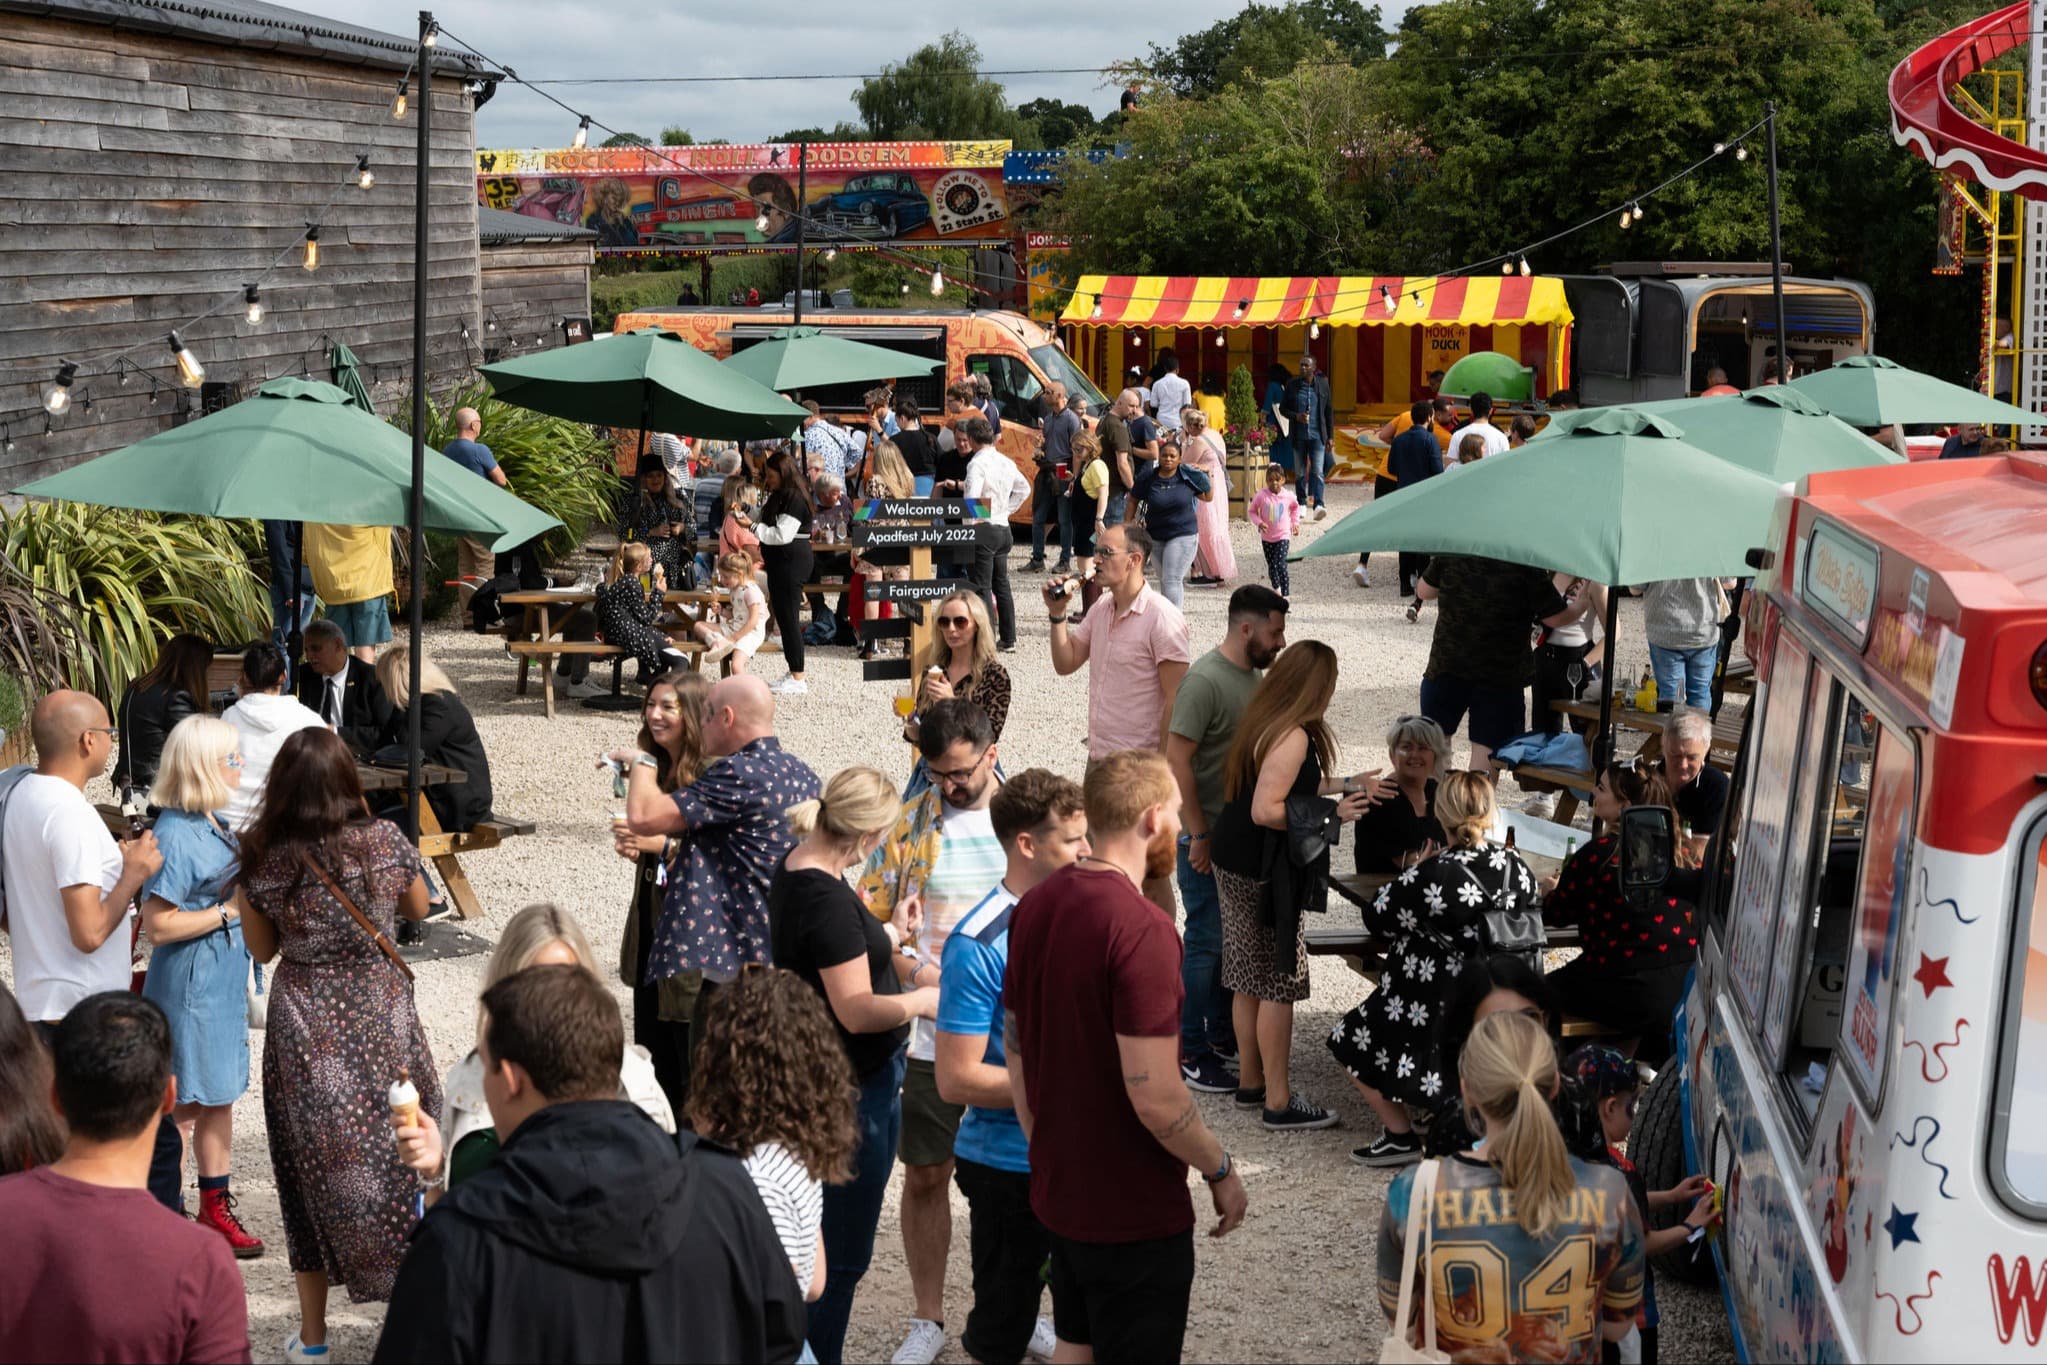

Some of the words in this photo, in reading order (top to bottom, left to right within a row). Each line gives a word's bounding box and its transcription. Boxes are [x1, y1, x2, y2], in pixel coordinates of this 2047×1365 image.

[545, 152, 615, 169] ROCK
[690, 149, 758, 168] ROLL
[486, 178, 519, 199] 35
[936, 175, 960, 211] FOLLOW
[964, 175, 978, 186] ME
[978, 184, 988, 198] TO
[941, 223, 953, 232] 22
[955, 215, 984, 228] State
[988, 210, 1004, 221] St.
[1432, 340, 1460, 350] DUCK
[885, 503, 944, 516] Welcome
[947, 503, 961, 515] to
[867, 530, 918, 545] Apadfest
[920, 531, 943, 544] July
[945, 529, 976, 541] 2022
[1419, 1233, 1602, 1347] 04
